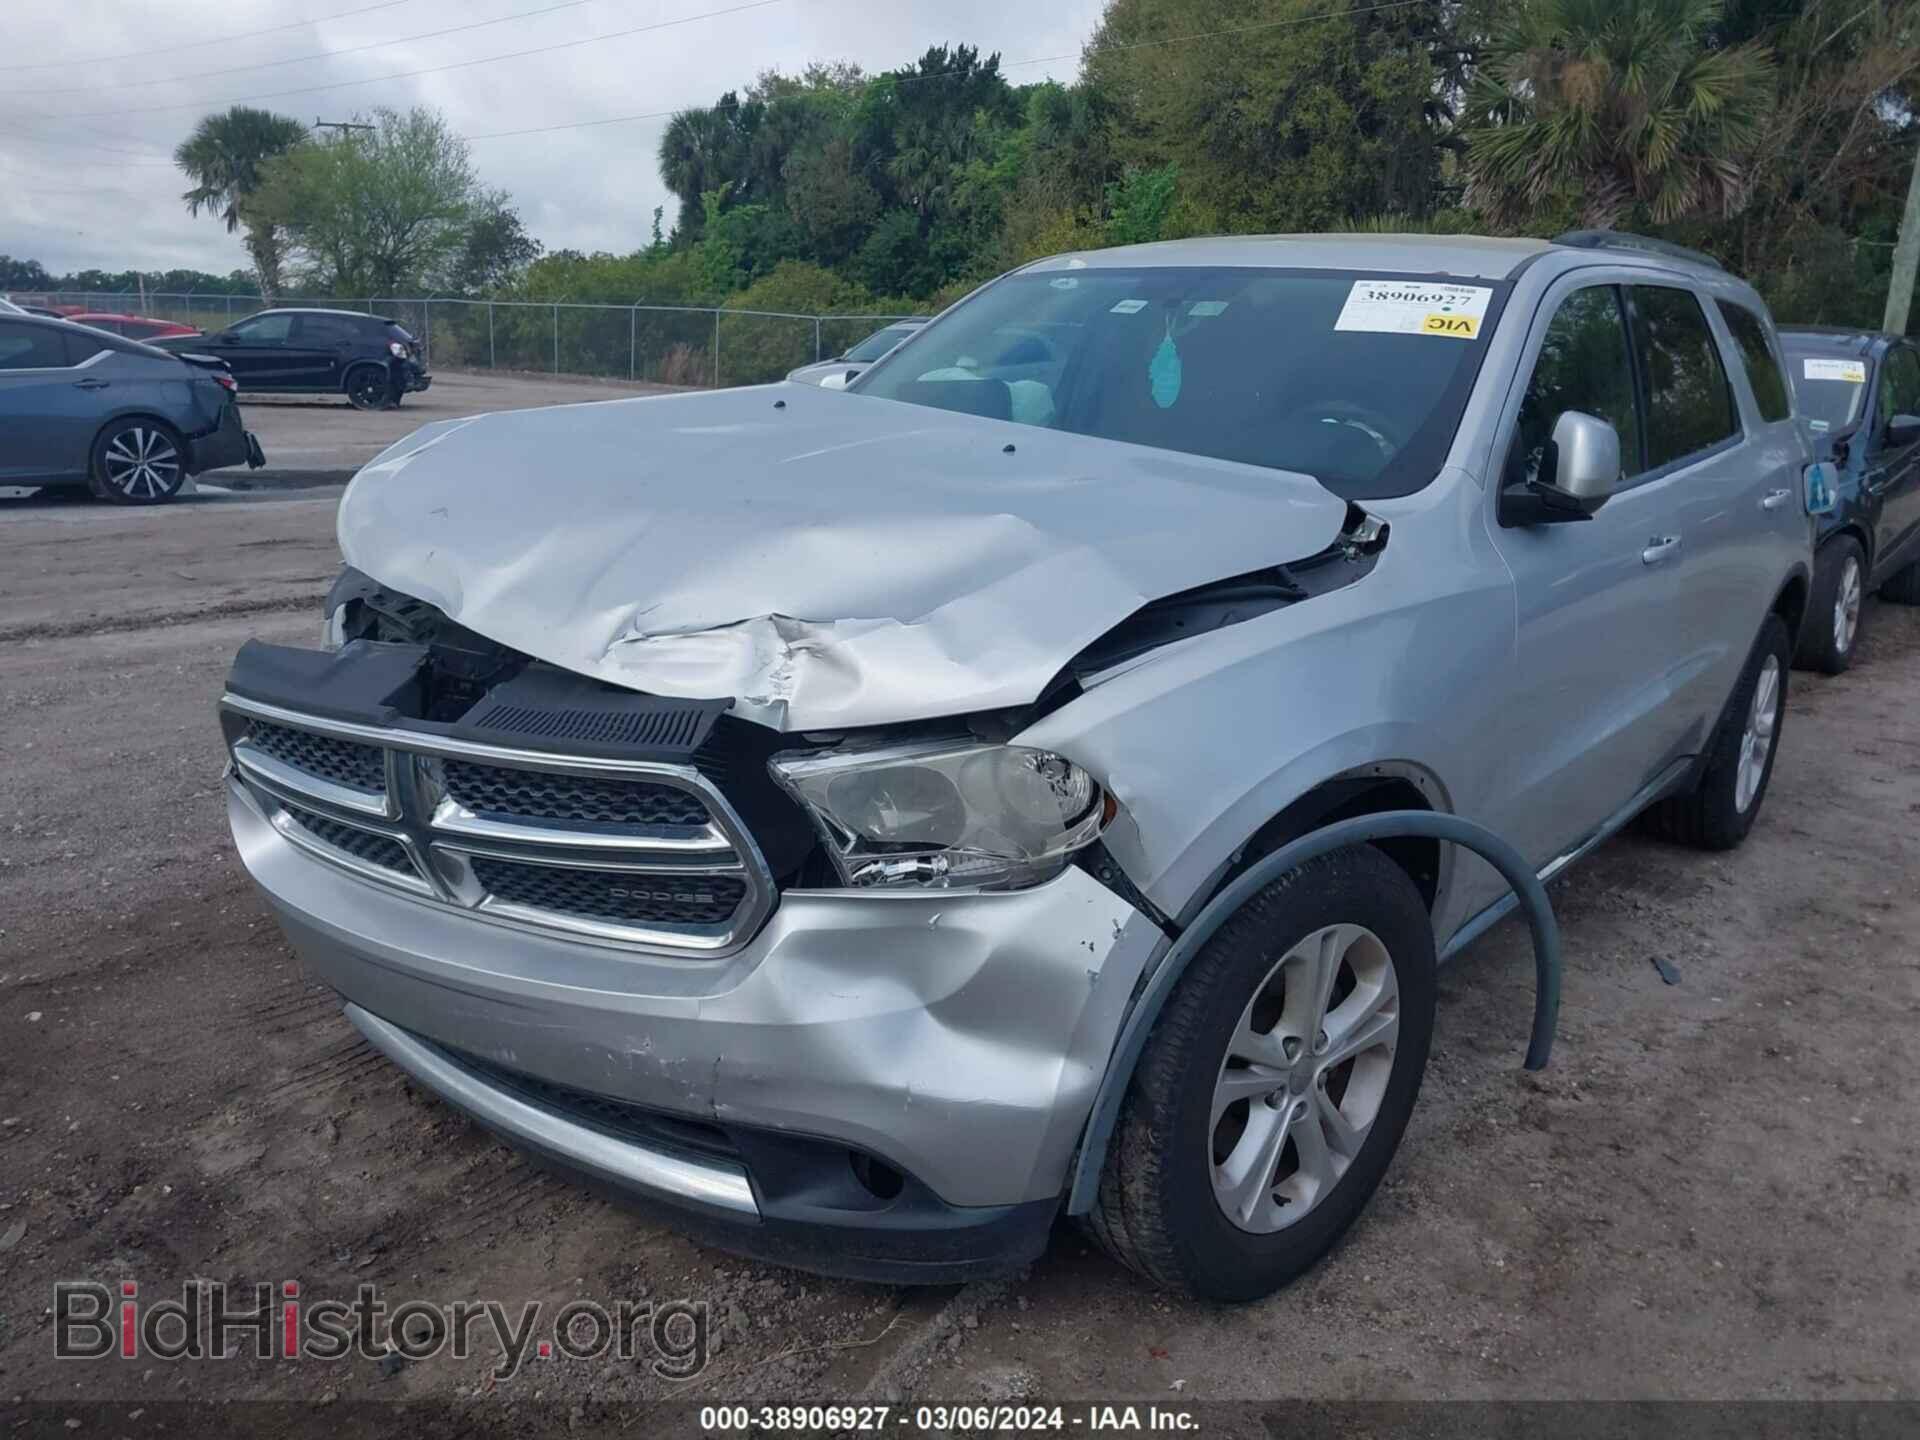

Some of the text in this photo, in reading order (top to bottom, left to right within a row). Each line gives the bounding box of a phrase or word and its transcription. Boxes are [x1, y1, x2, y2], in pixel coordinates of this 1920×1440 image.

[1362, 290, 1472, 306] 38906927
[1428, 318, 1472, 332] VIC
[609, 888, 715, 904] DODGE
